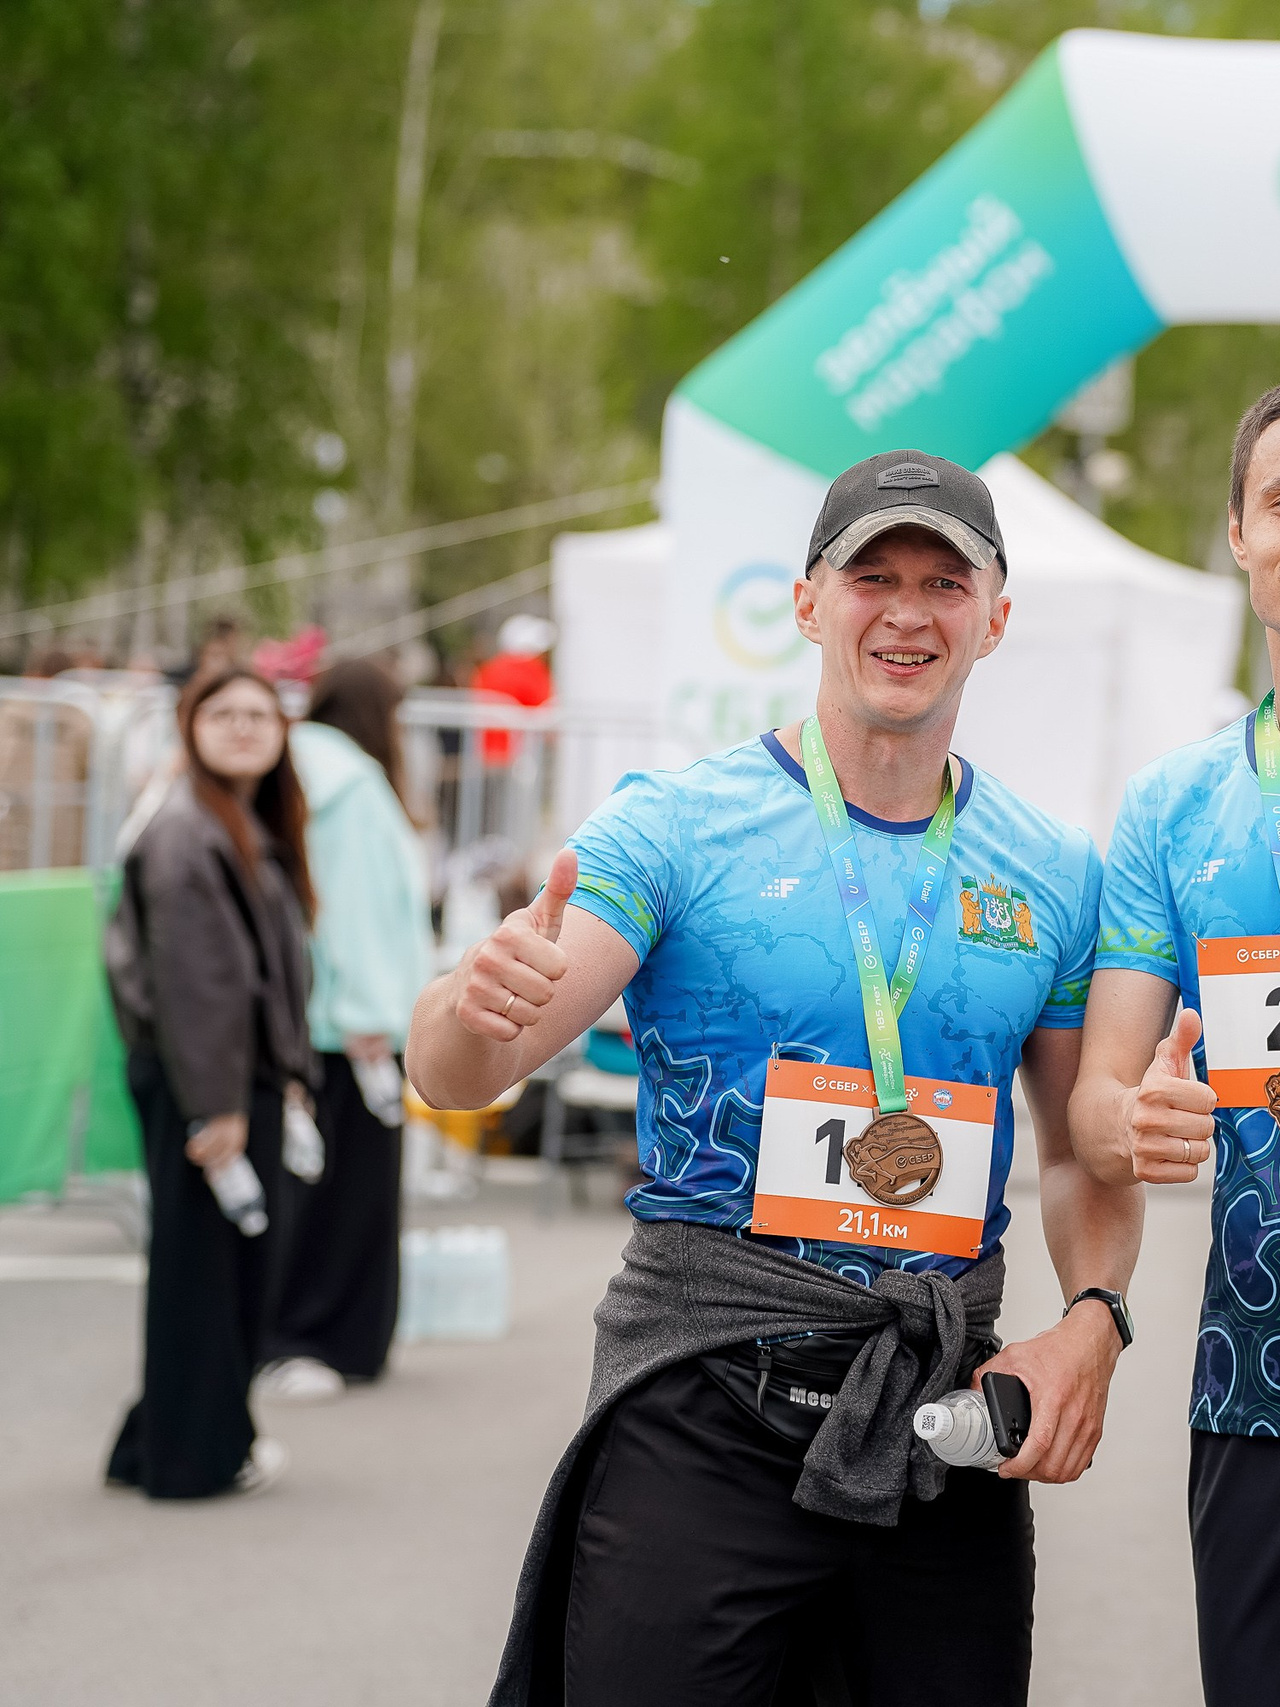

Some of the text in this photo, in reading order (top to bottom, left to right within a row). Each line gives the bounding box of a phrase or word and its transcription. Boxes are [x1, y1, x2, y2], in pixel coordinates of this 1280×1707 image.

[843, 857, 855, 879] Utair
[921, 880, 933, 903] Utair
[857, 921, 872, 952] СБЕР
[906, 943, 920, 974] СБЕР
[1251, 950, 1280, 960] СБЕР
[873, 984, 885, 1031] 185 лет
[828, 1079, 858, 1093] СБЕР
[908, 1153, 934, 1165] СБЕР
[790, 1386, 838, 1409] Mee
